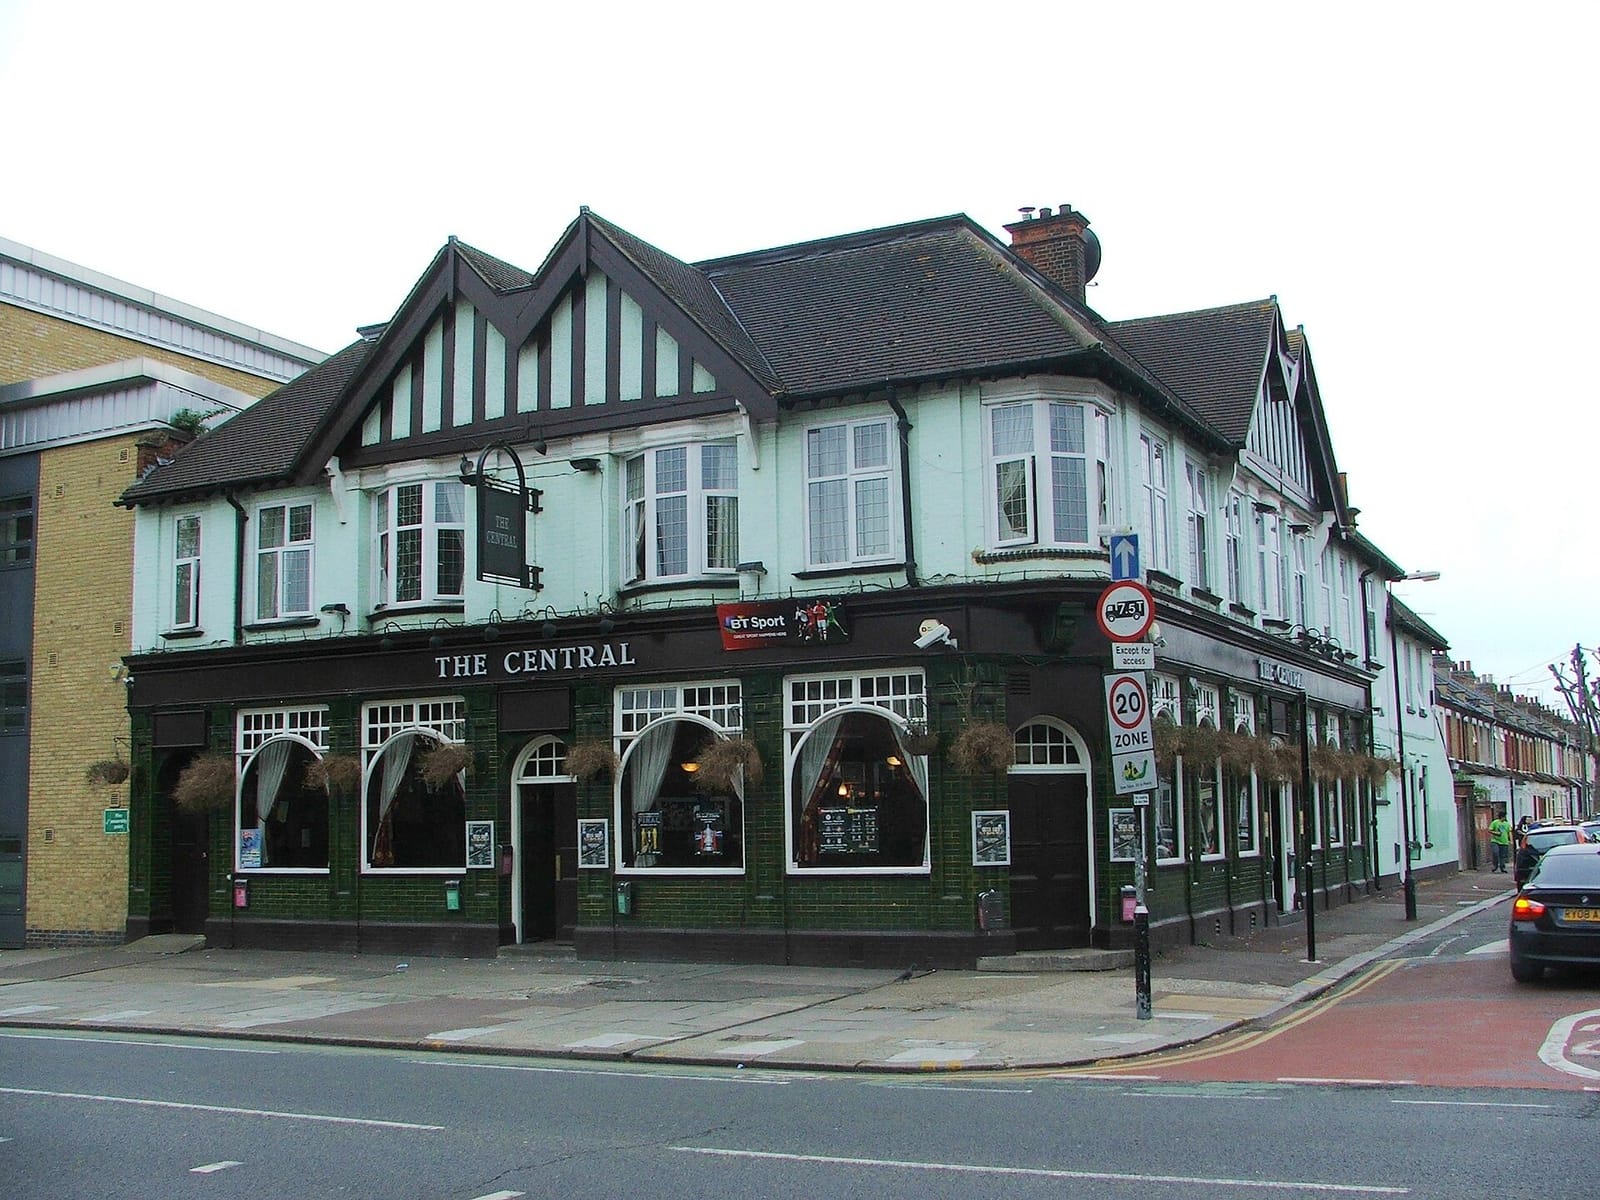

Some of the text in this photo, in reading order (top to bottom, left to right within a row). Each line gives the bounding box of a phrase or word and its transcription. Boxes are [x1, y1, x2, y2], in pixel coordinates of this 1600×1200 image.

[495, 515, 509, 529] THE
[486, 530, 518, 549] CENTRAL
[730, 615, 786, 630] BT Sport
[1115, 646, 1151, 655] Except for
[434, 642, 636, 678] THE CENTRAL
[1115, 691, 1141, 715] 20
[1114, 731, 1149, 748] ZONE
